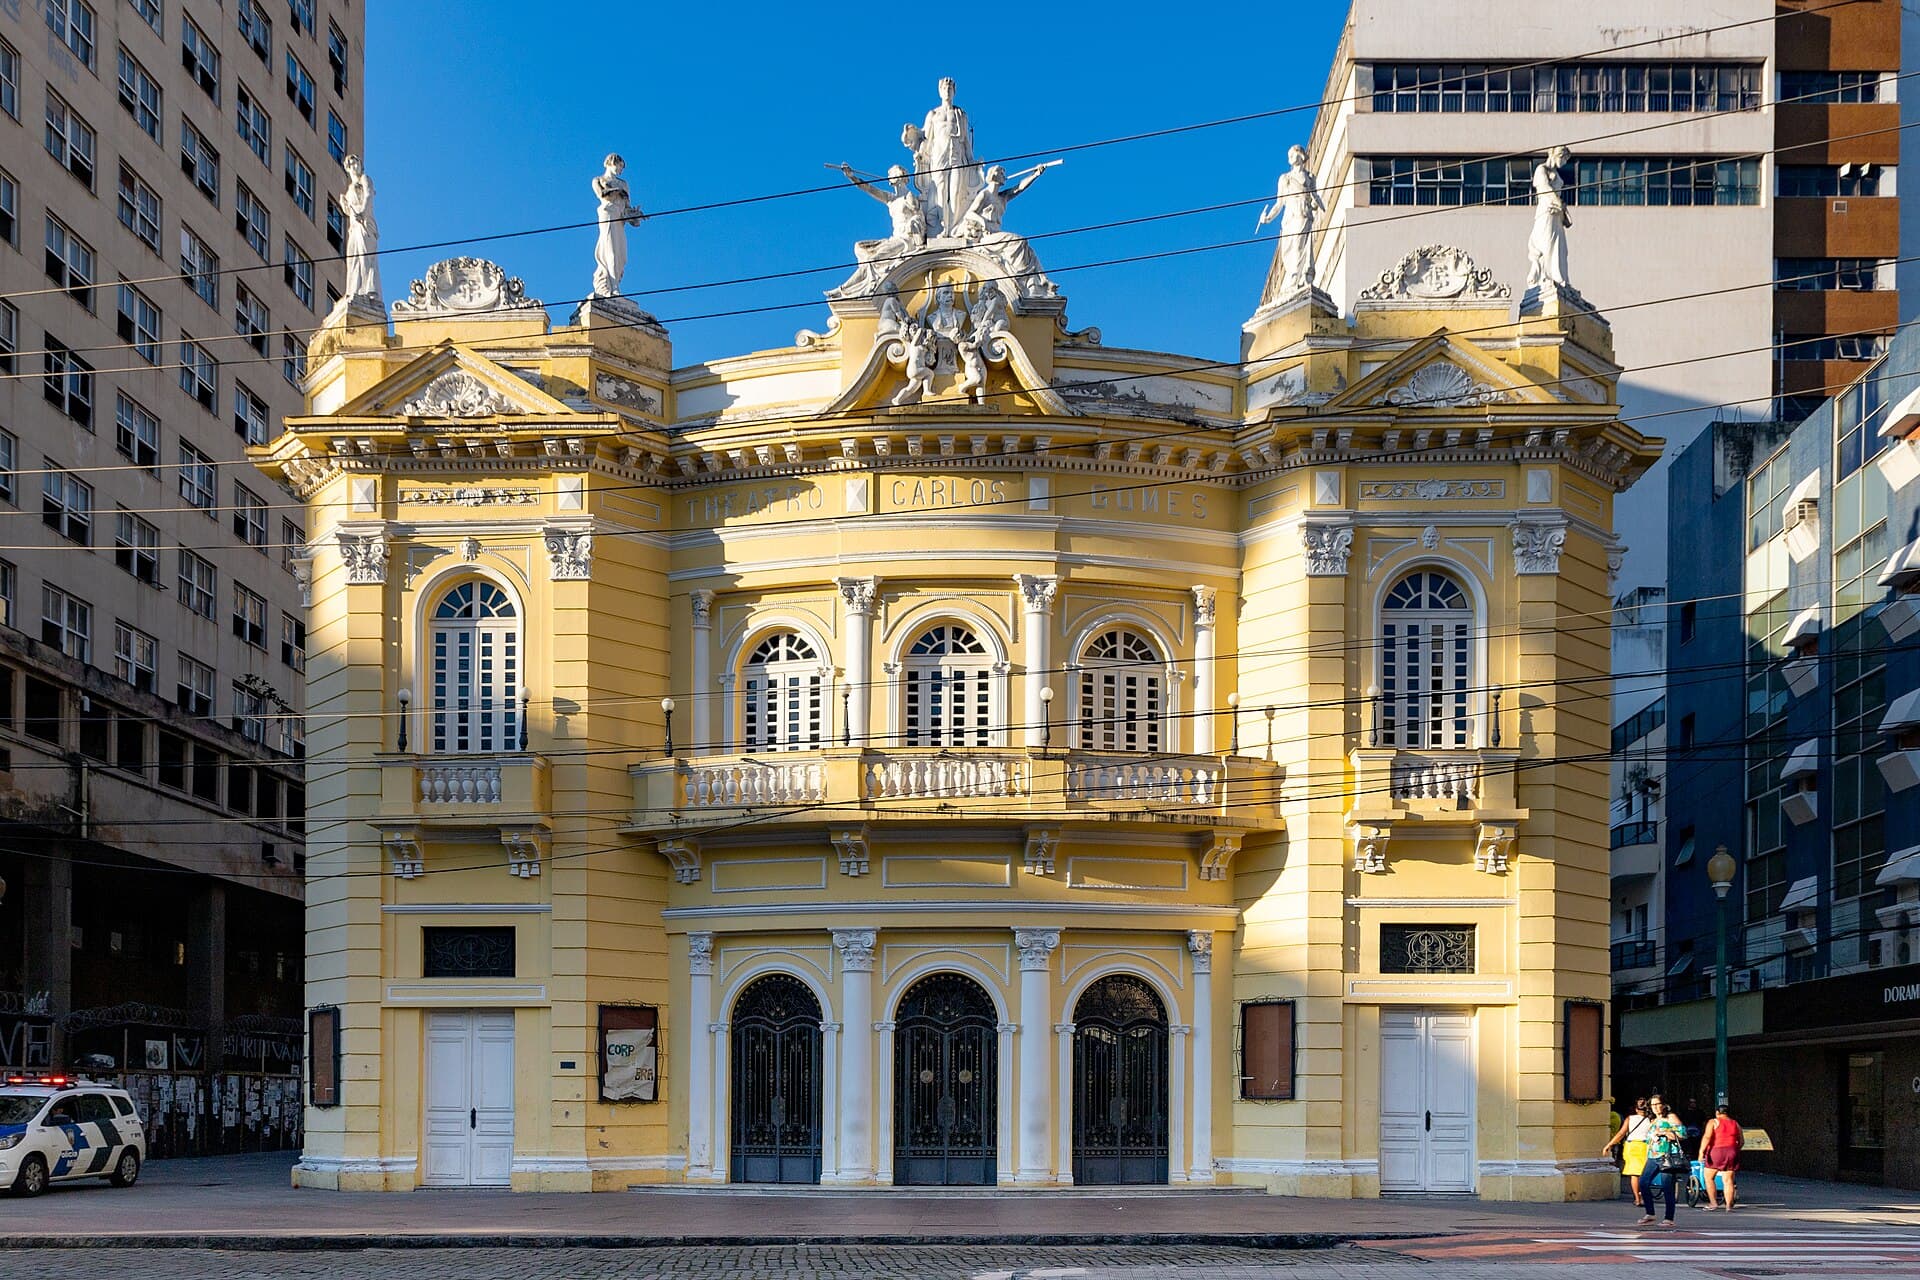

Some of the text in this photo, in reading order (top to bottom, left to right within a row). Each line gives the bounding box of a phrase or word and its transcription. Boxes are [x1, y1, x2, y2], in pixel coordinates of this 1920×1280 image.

[687, 481, 1208, 523] THEATRO CARLOS GOMES
